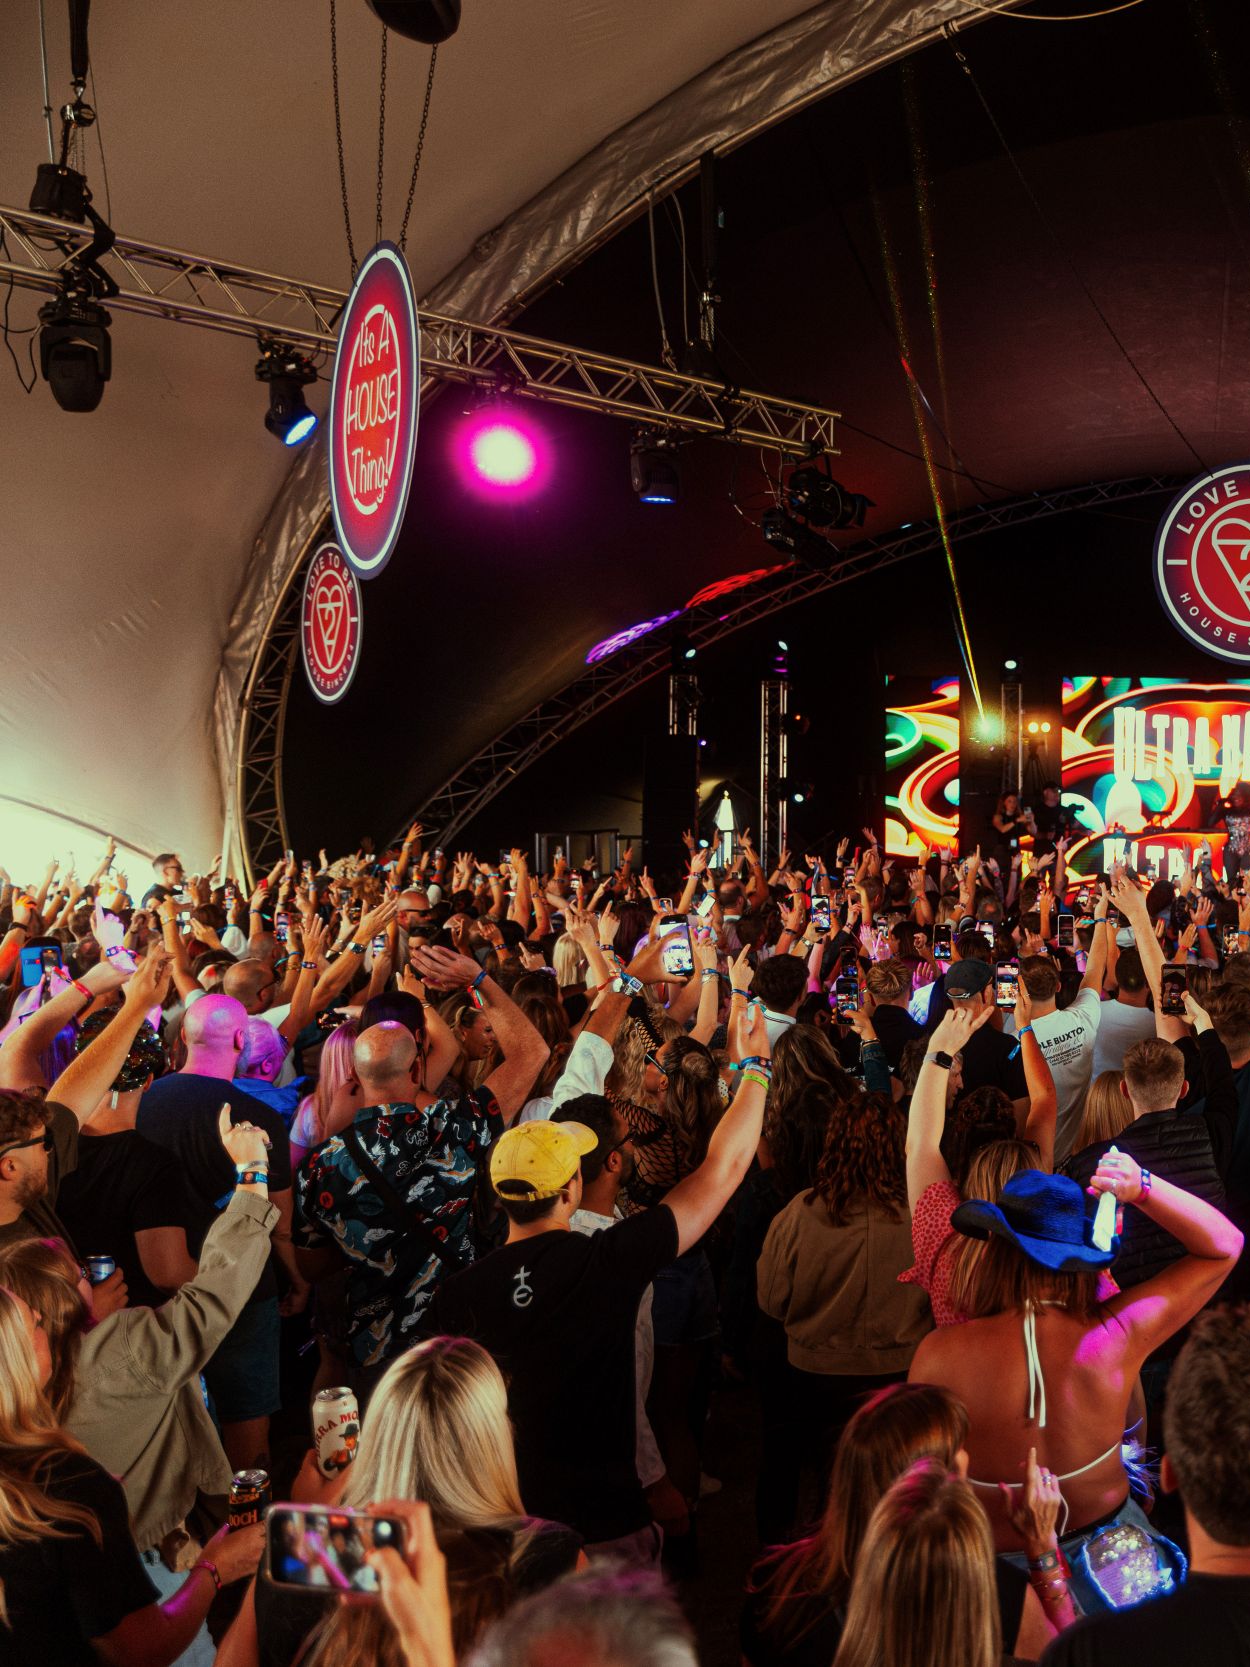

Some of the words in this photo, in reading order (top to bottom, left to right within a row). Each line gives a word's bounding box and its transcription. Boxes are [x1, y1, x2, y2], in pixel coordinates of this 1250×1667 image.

[359, 321, 374, 368] Its
[378, 309, 390, 361] A
[347, 369, 397, 435] HOUSE
[352, 438, 390, 503] Thing!
[1176, 480, 1239, 535] LOVE
[307, 556, 325, 601] LOVE
[328, 552, 340, 568] TO
[342, 569, 354, 594] BE
[1180, 592, 1237, 644] HOUSE
[1113, 706, 1211, 781] ULTRA
[1038, 1038, 1053, 1049] LE
